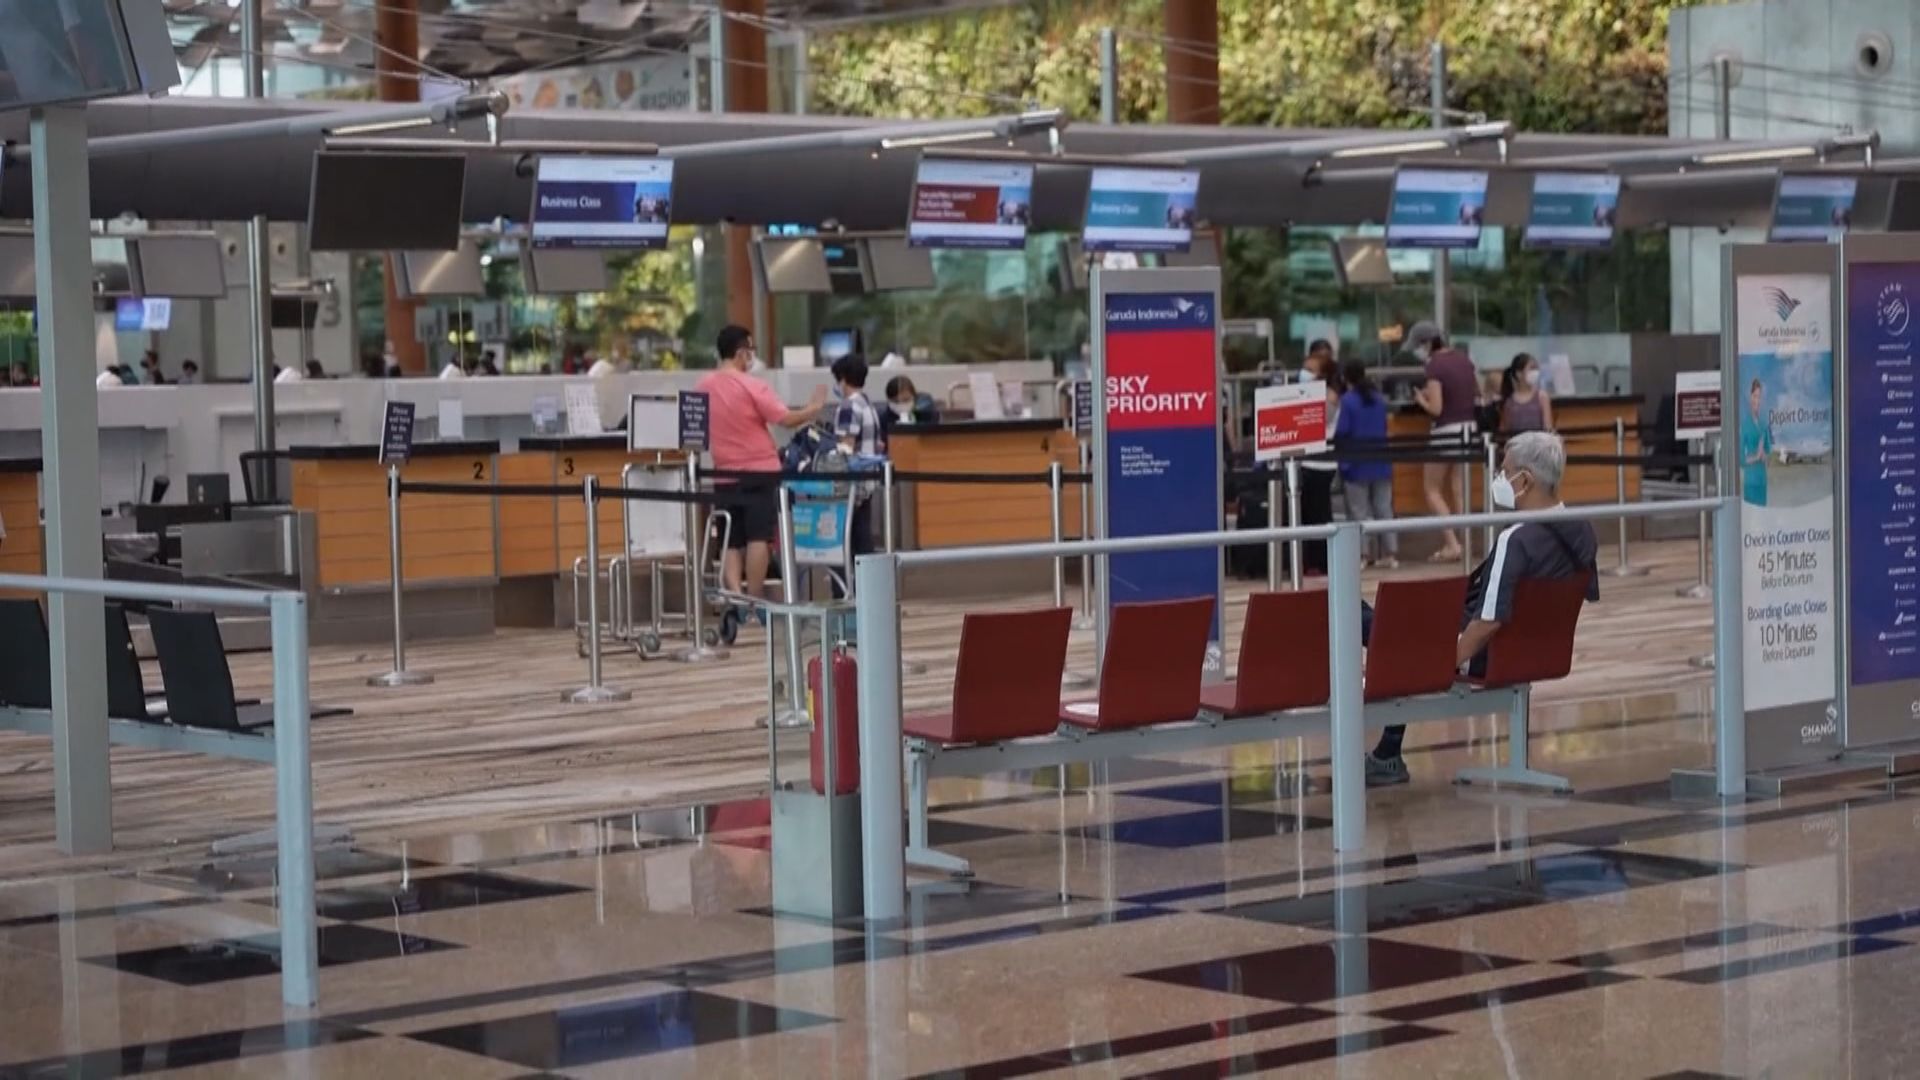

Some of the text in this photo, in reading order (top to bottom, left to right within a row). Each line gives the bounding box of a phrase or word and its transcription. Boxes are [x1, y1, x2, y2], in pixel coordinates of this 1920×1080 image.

[541, 195, 602, 209] Business Class
[1105, 307, 1179, 321] Garuda Indonesia
[1106, 375, 1149, 395] SKY
[1106, 391, 1208, 414] PRIORITY
[1260, 424, 1277, 436] SKY
[1260, 430, 1299, 445] PRIORITY
[473, 461, 484, 480] 2
[563, 457, 575, 476] 3
[1776, 530, 1806, 546] Counter
[1807, 528, 1831, 543] Closes
[1758, 549, 1818, 574] 45 Minutes
[1747, 599, 1829, 621] Boarding Gate Closes
[1760, 622, 1818, 647] 10 Minutes
[1801, 721, 1837, 738] CHANGI
